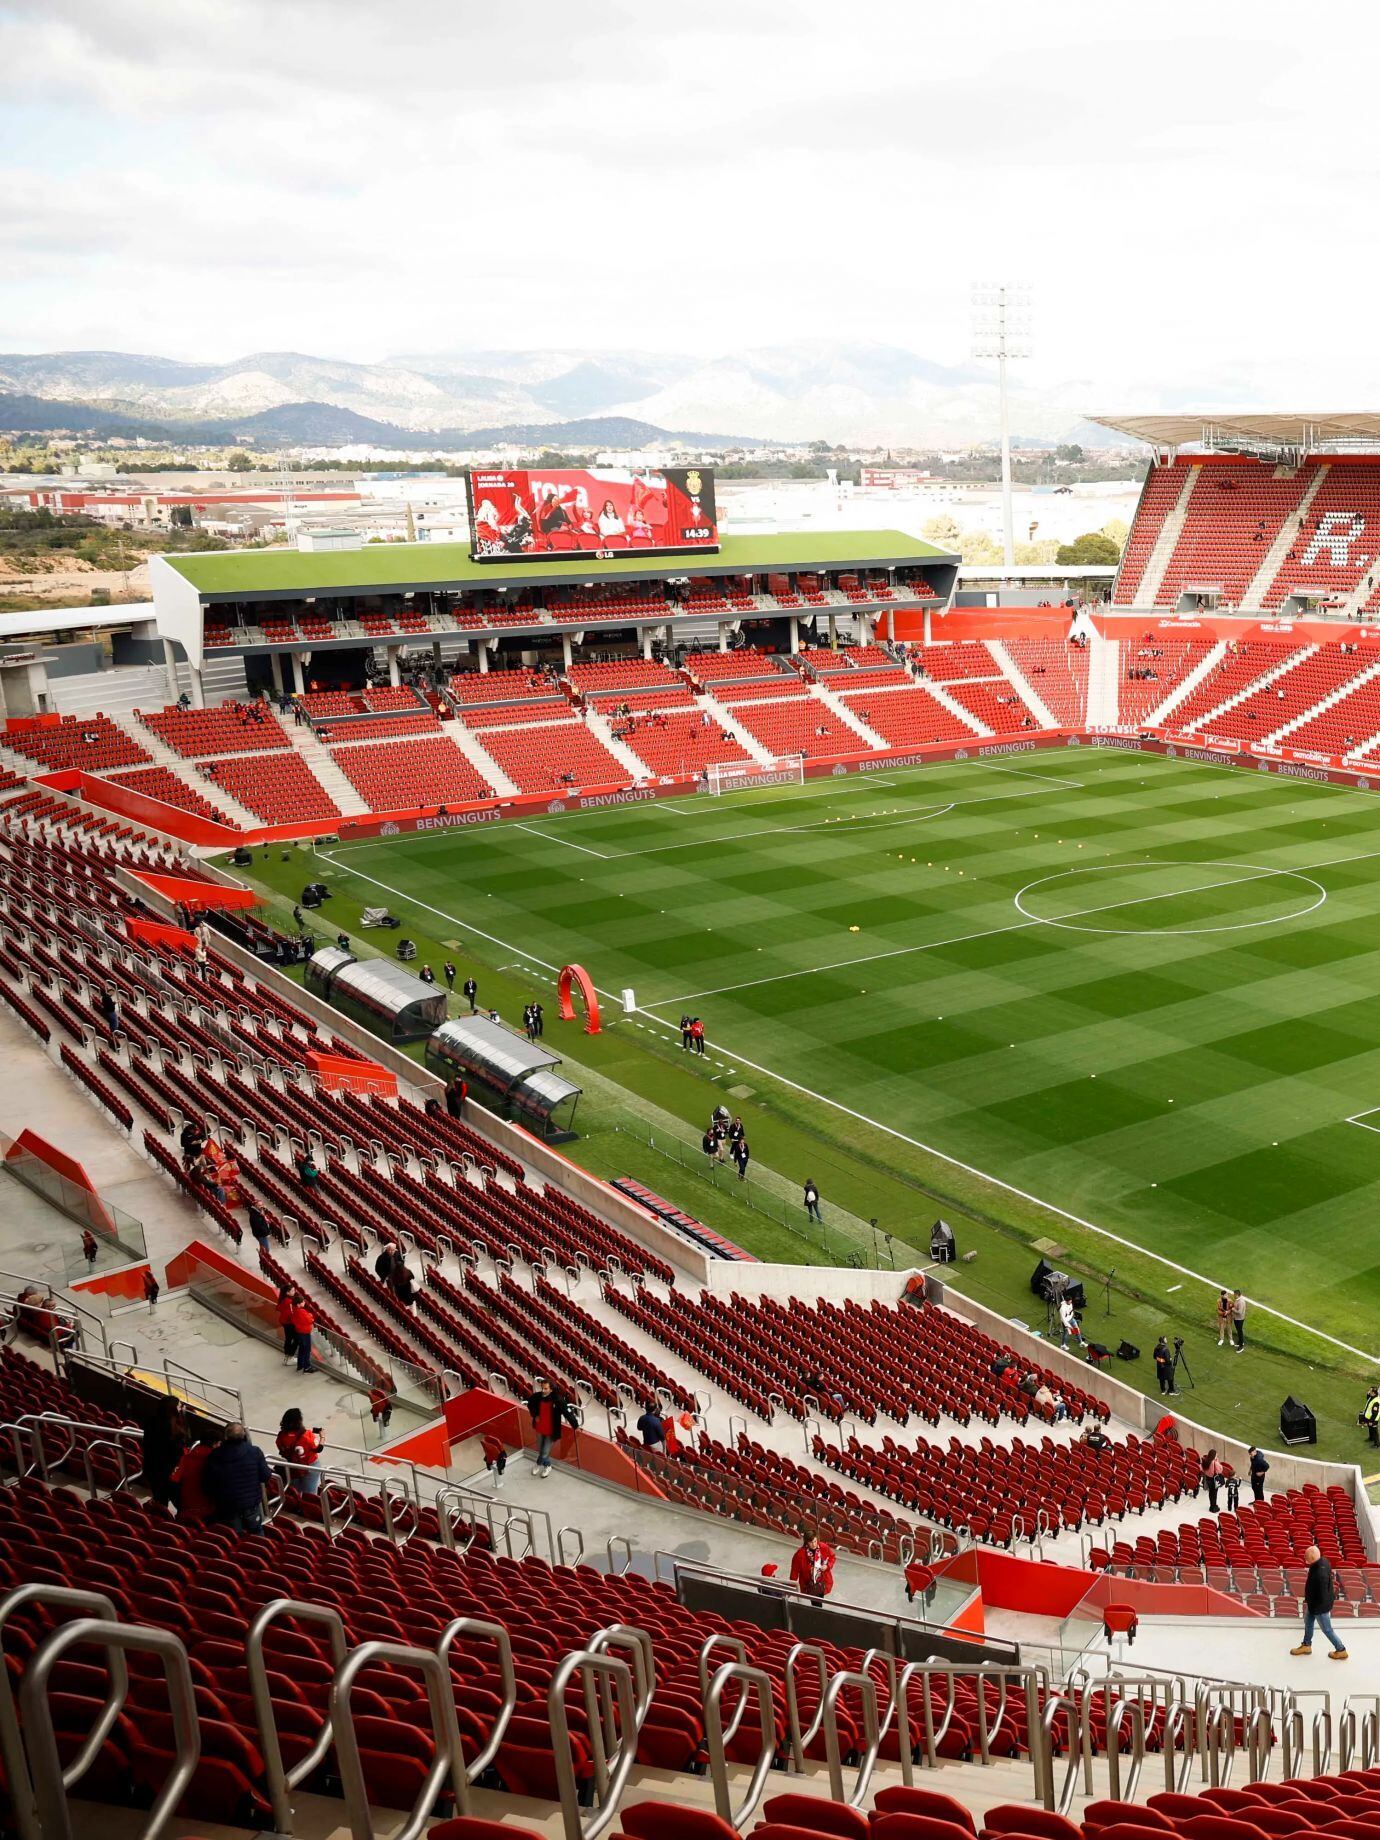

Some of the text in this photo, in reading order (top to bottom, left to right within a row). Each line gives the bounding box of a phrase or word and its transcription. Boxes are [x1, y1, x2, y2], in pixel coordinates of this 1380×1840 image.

[685, 528, 710, 538] 14:39
[978, 741, 1036, 756] BENVINGUTS
[1184, 749, 1231, 765] BENVINGUTS
[859, 755, 922, 772] BENVINGUTS
[726, 770, 794, 789] BENVINGUTS
[1277, 764, 1329, 782] BENVINGUTS
[580, 788, 656, 808] BENVINGUTS
[416, 809, 501, 831] BENVINGUTS
